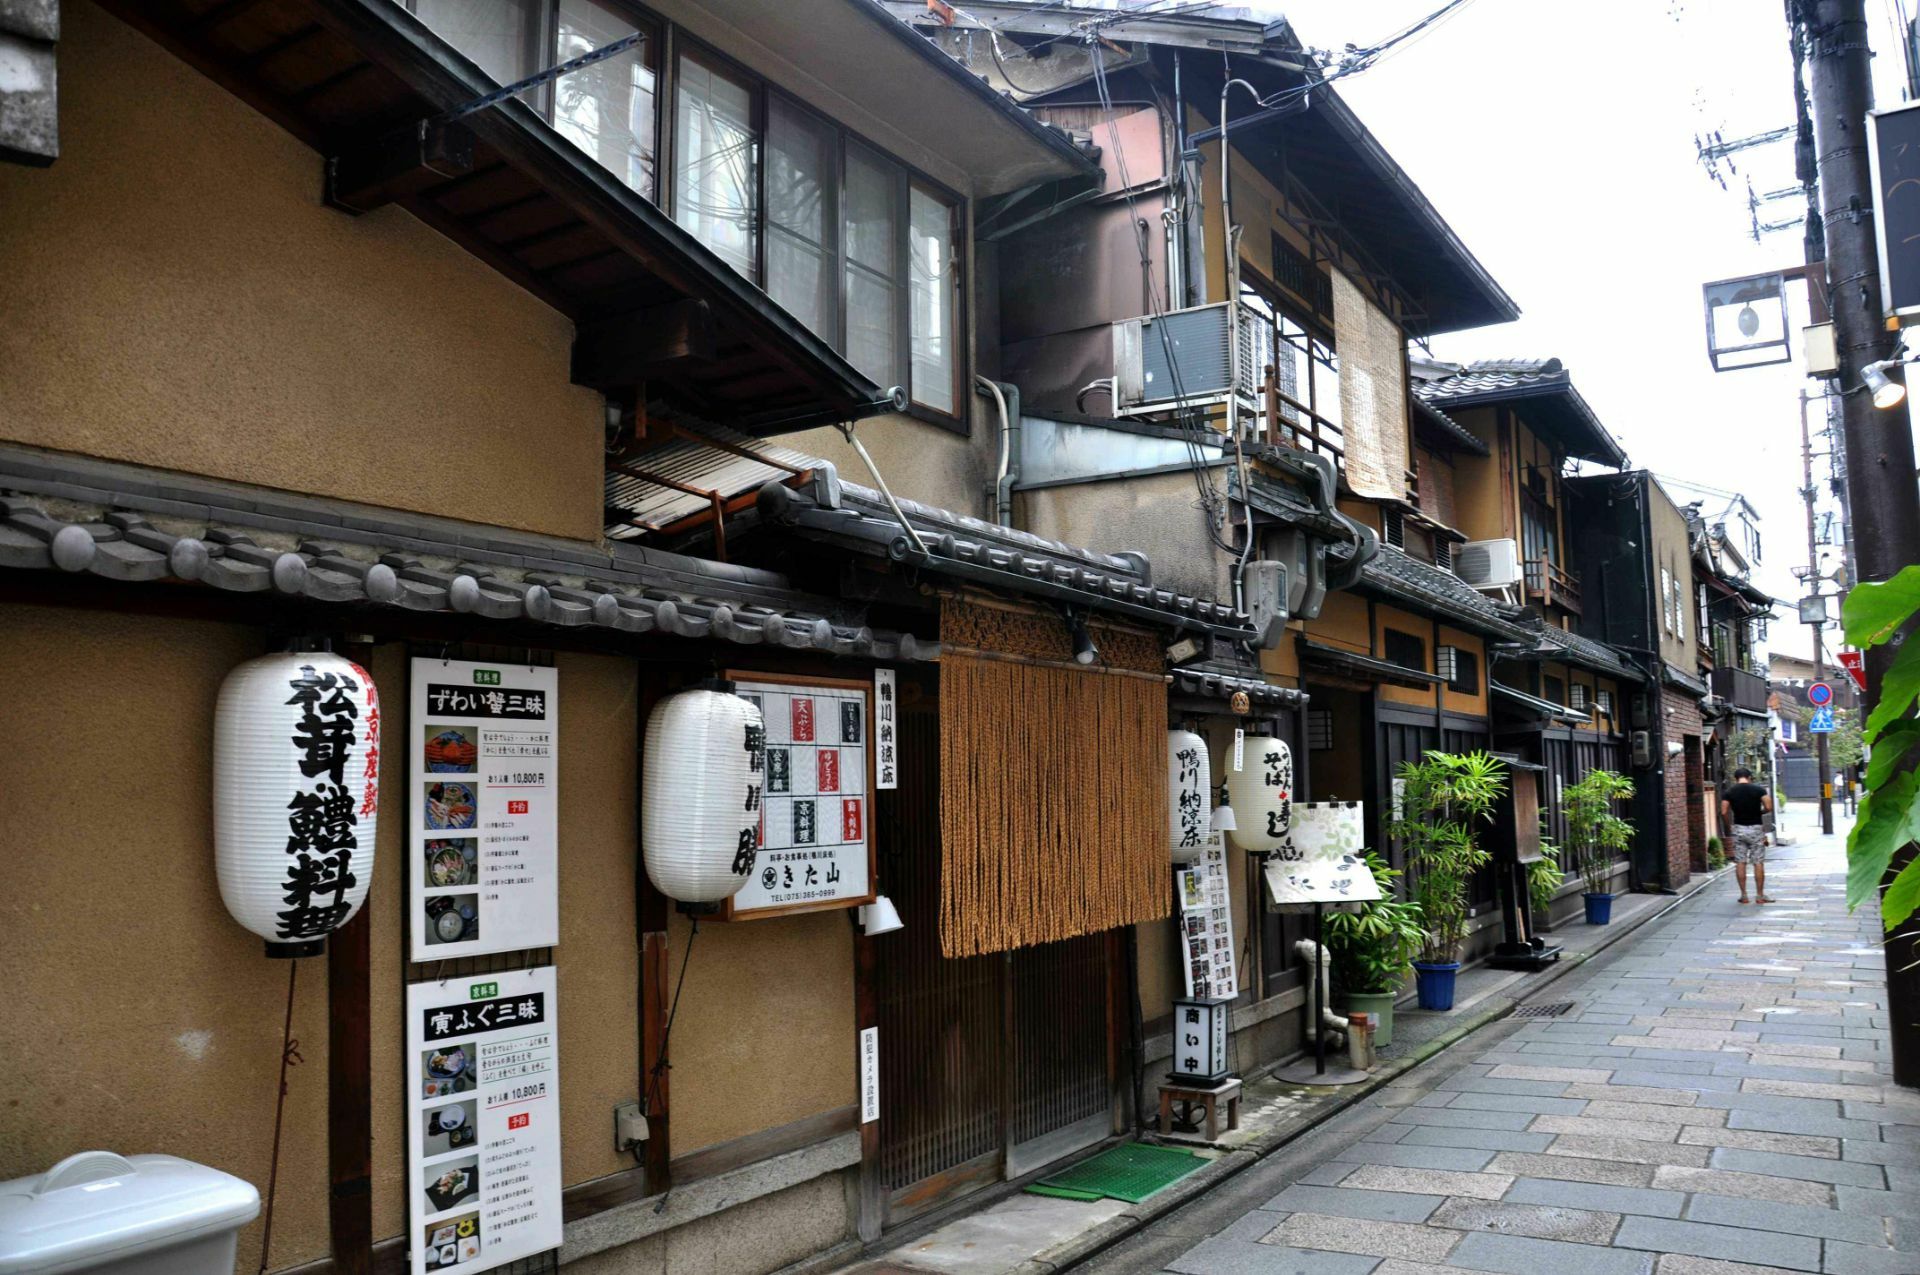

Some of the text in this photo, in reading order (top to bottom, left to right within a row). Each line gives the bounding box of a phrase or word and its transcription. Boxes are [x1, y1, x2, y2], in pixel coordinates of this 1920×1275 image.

[429, 689, 545, 715] ずわい蟹三昧
[798, 700, 807, 740] 天ぷら
[1263, 752, 1283, 787] そば
[1176, 748, 1201, 848] 鴨川納涼床
[799, 802, 809, 843] 京料理
[783, 862, 840, 888] きた山
[430, 998, 538, 1035] 寅ふぐ三昧
[1184, 1007, 1200, 1073] 商い中
